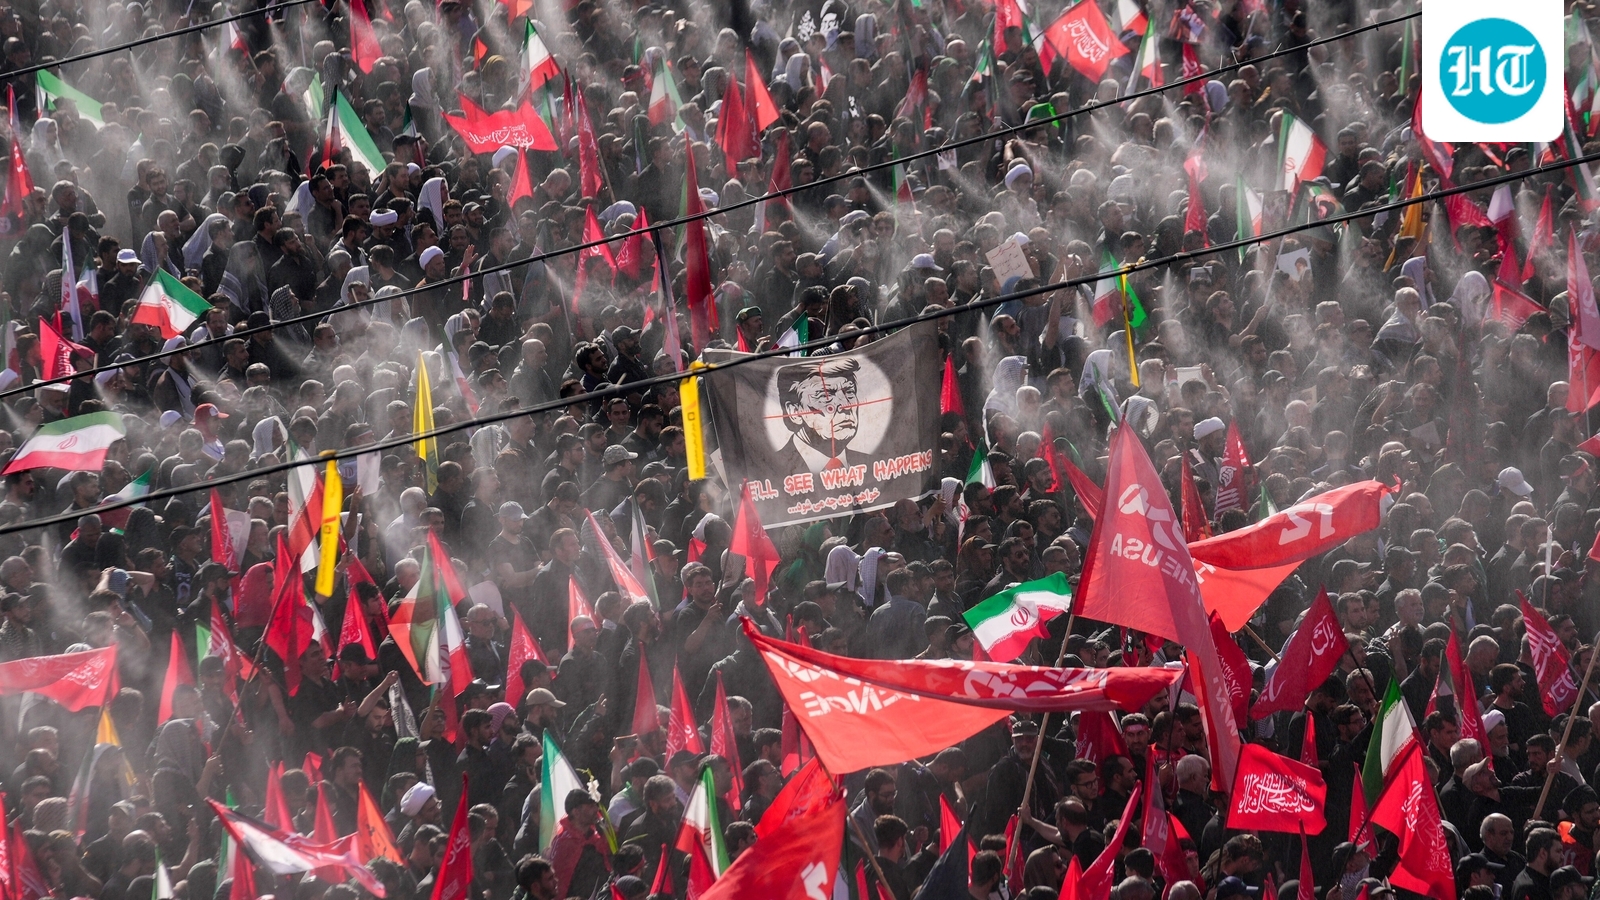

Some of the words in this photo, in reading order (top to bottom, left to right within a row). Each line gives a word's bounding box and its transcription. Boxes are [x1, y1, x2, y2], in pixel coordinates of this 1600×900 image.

[740, 480, 779, 501] E'LL
[784, 473, 814, 496] SEE
[820, 464, 867, 491] WHAT
[874, 449, 933, 481] HAPPENS
